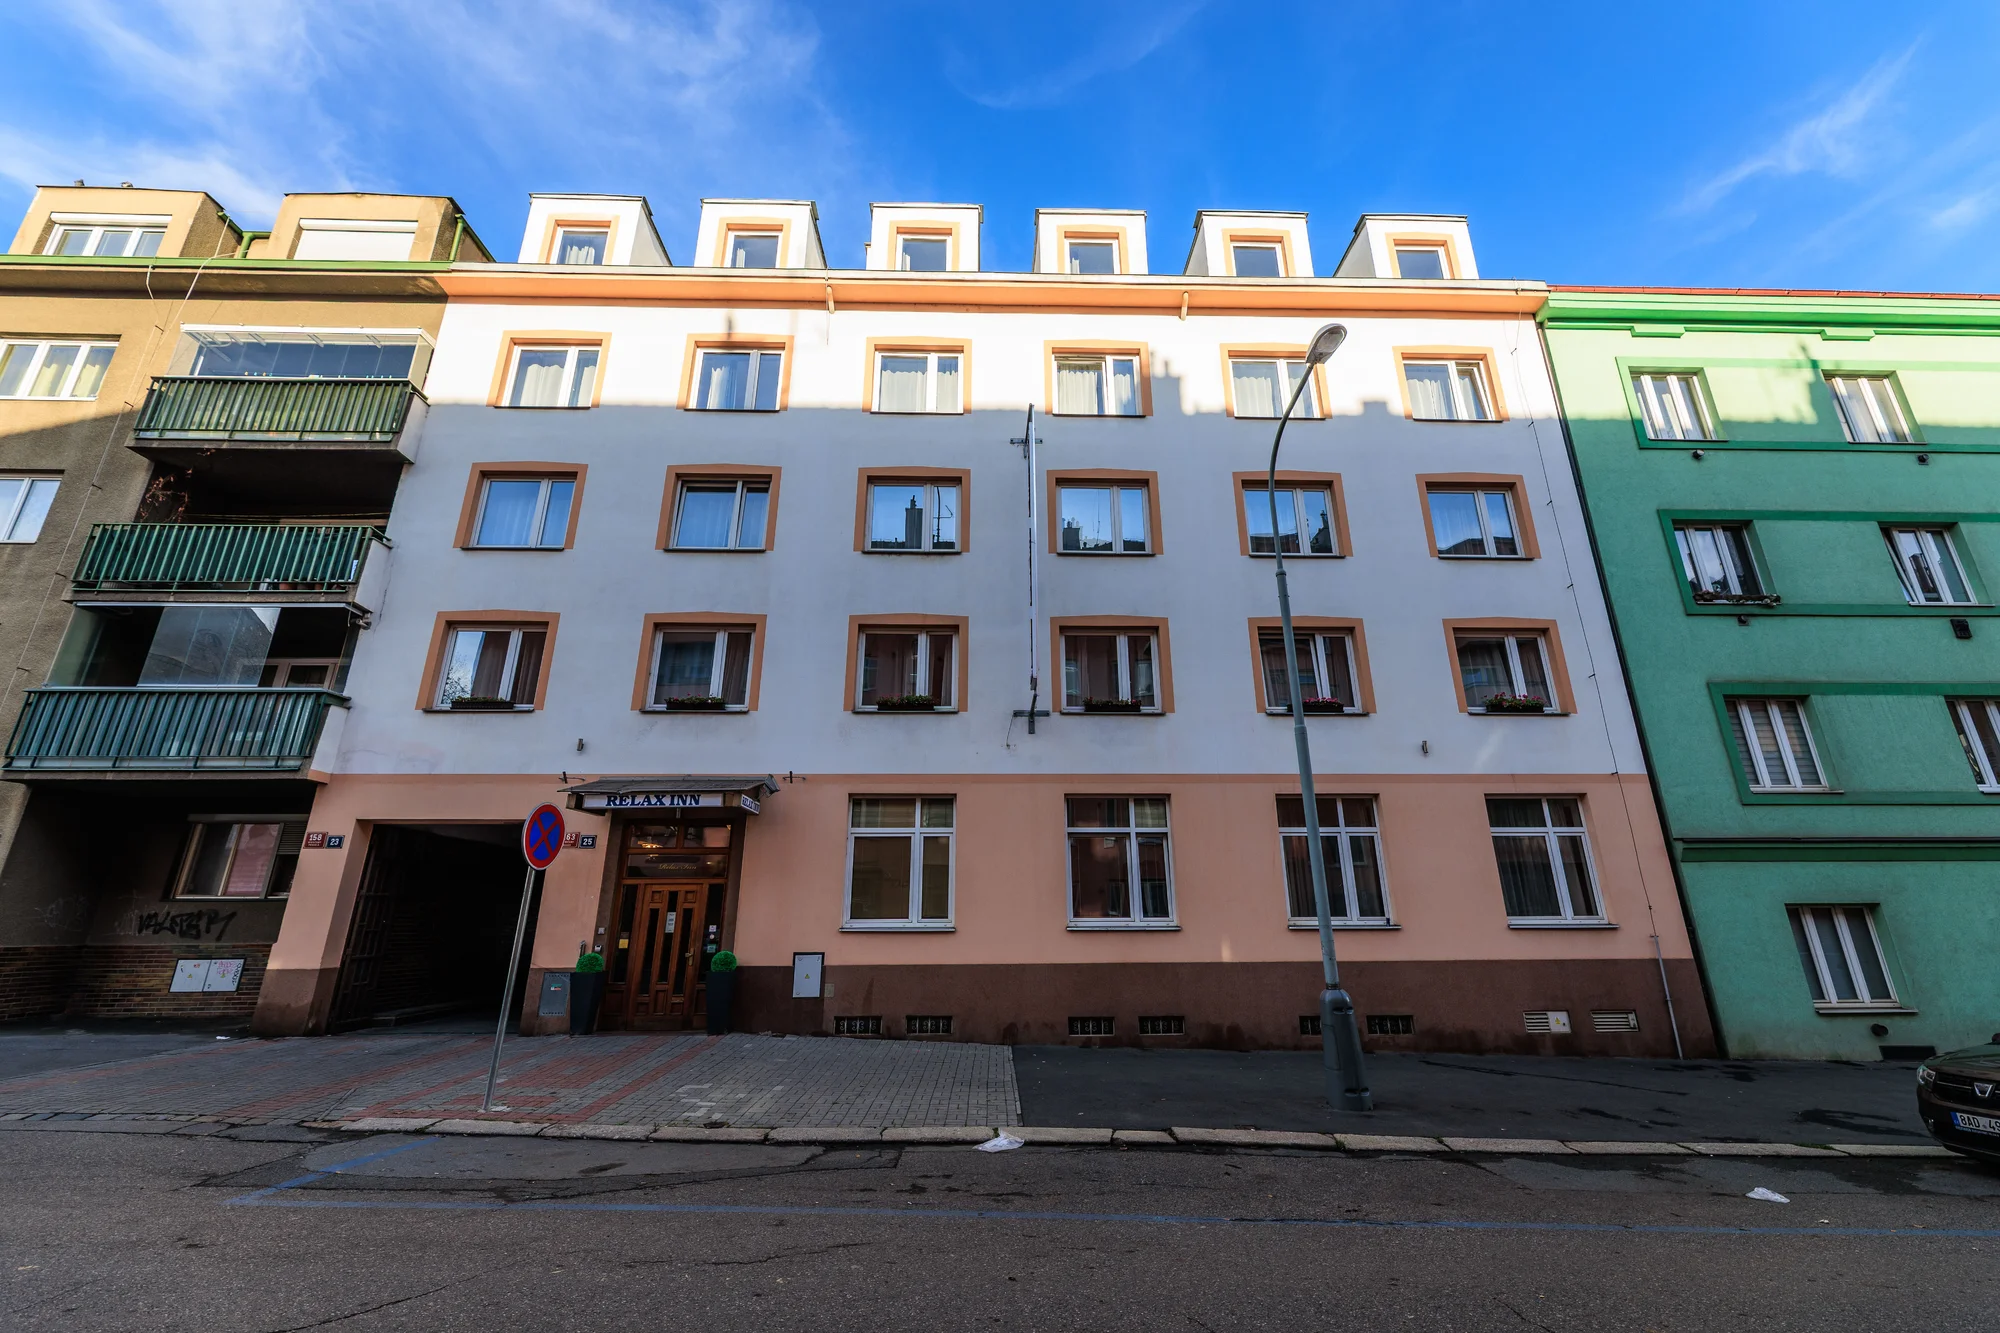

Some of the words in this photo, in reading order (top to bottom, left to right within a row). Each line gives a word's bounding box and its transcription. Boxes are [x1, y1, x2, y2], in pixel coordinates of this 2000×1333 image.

[605, 794, 667, 807] RELAX
[669, 793, 701, 806] INN
[309, 833, 322, 841] 158
[566, 833, 576, 841] 63
[330, 838, 339, 846] 23
[583, 838, 593, 846] 25
[1959, 1114, 1980, 1128] 8AD
